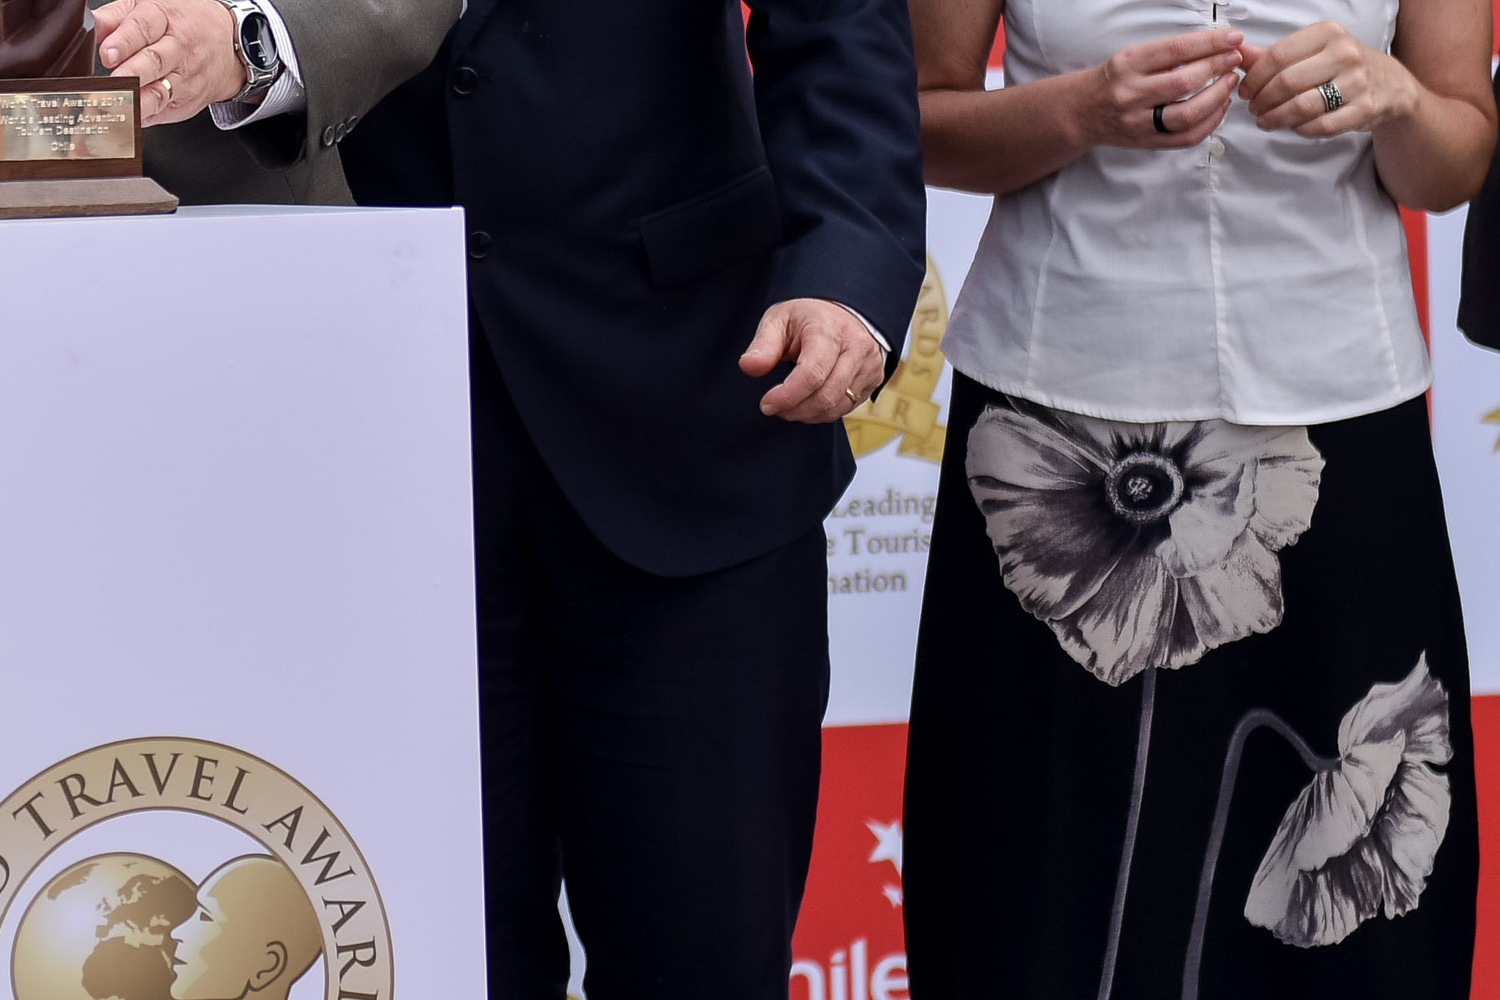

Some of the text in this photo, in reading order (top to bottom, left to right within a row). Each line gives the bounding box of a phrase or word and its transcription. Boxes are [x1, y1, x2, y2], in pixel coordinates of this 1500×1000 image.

[844, 527, 931, 555] Touris
[828, 568, 907, 594] nation
[12, 753, 251, 841] TRAVEL
[261, 805, 380, 1000] AWAR
[789, 937, 911, 1000] ile
